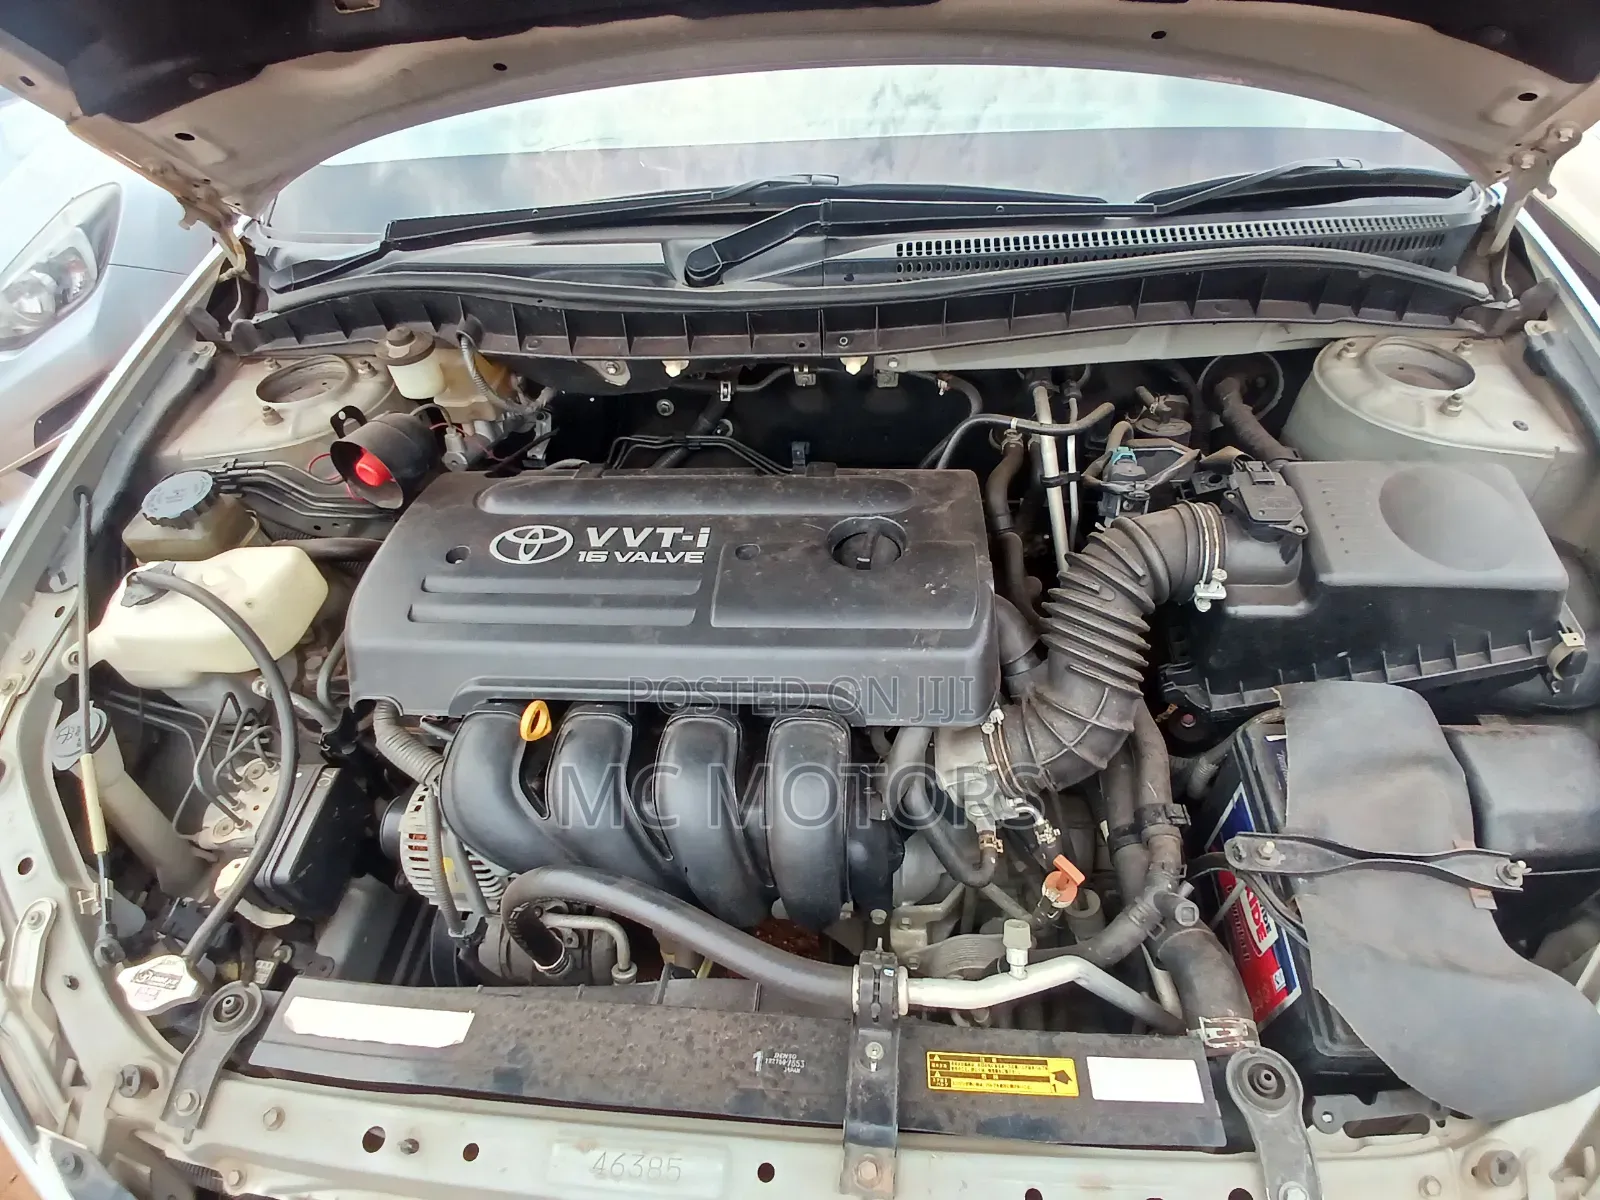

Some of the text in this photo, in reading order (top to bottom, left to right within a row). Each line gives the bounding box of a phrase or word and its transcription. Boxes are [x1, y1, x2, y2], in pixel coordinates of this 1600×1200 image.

[586, 526, 711, 548] VVT-i
[578, 551, 705, 563] 16 VALVE
[753, 1050, 764, 1072] 1
[592, 1151, 683, 1182] 46385
